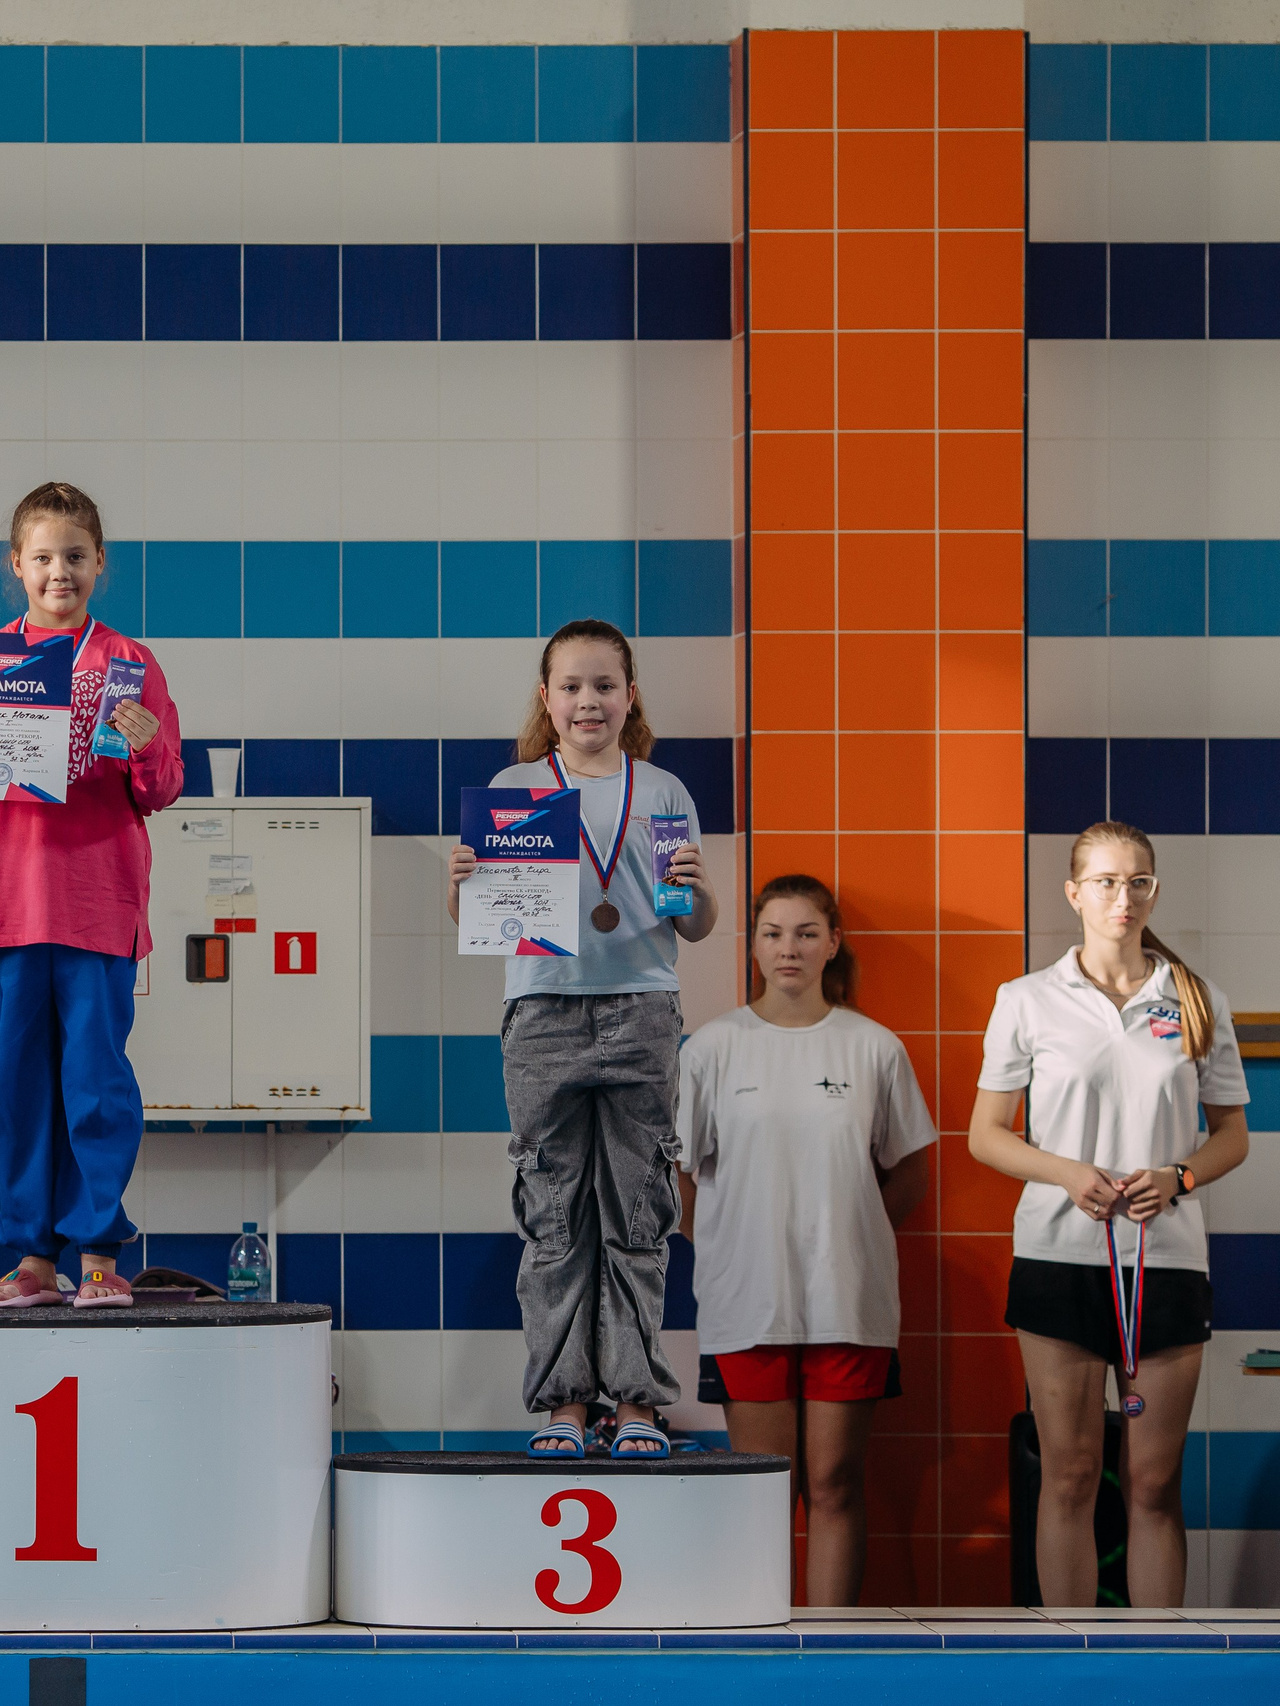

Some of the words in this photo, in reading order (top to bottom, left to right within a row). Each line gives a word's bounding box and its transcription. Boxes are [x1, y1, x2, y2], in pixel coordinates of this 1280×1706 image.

[105, 683, 141, 698] Milka
[485, 834, 554, 848] ГРАМОТА
[654, 837, 688, 855] Milka
[15, 1376, 97, 1561] 1
[535, 1488, 622, 1614] 3
